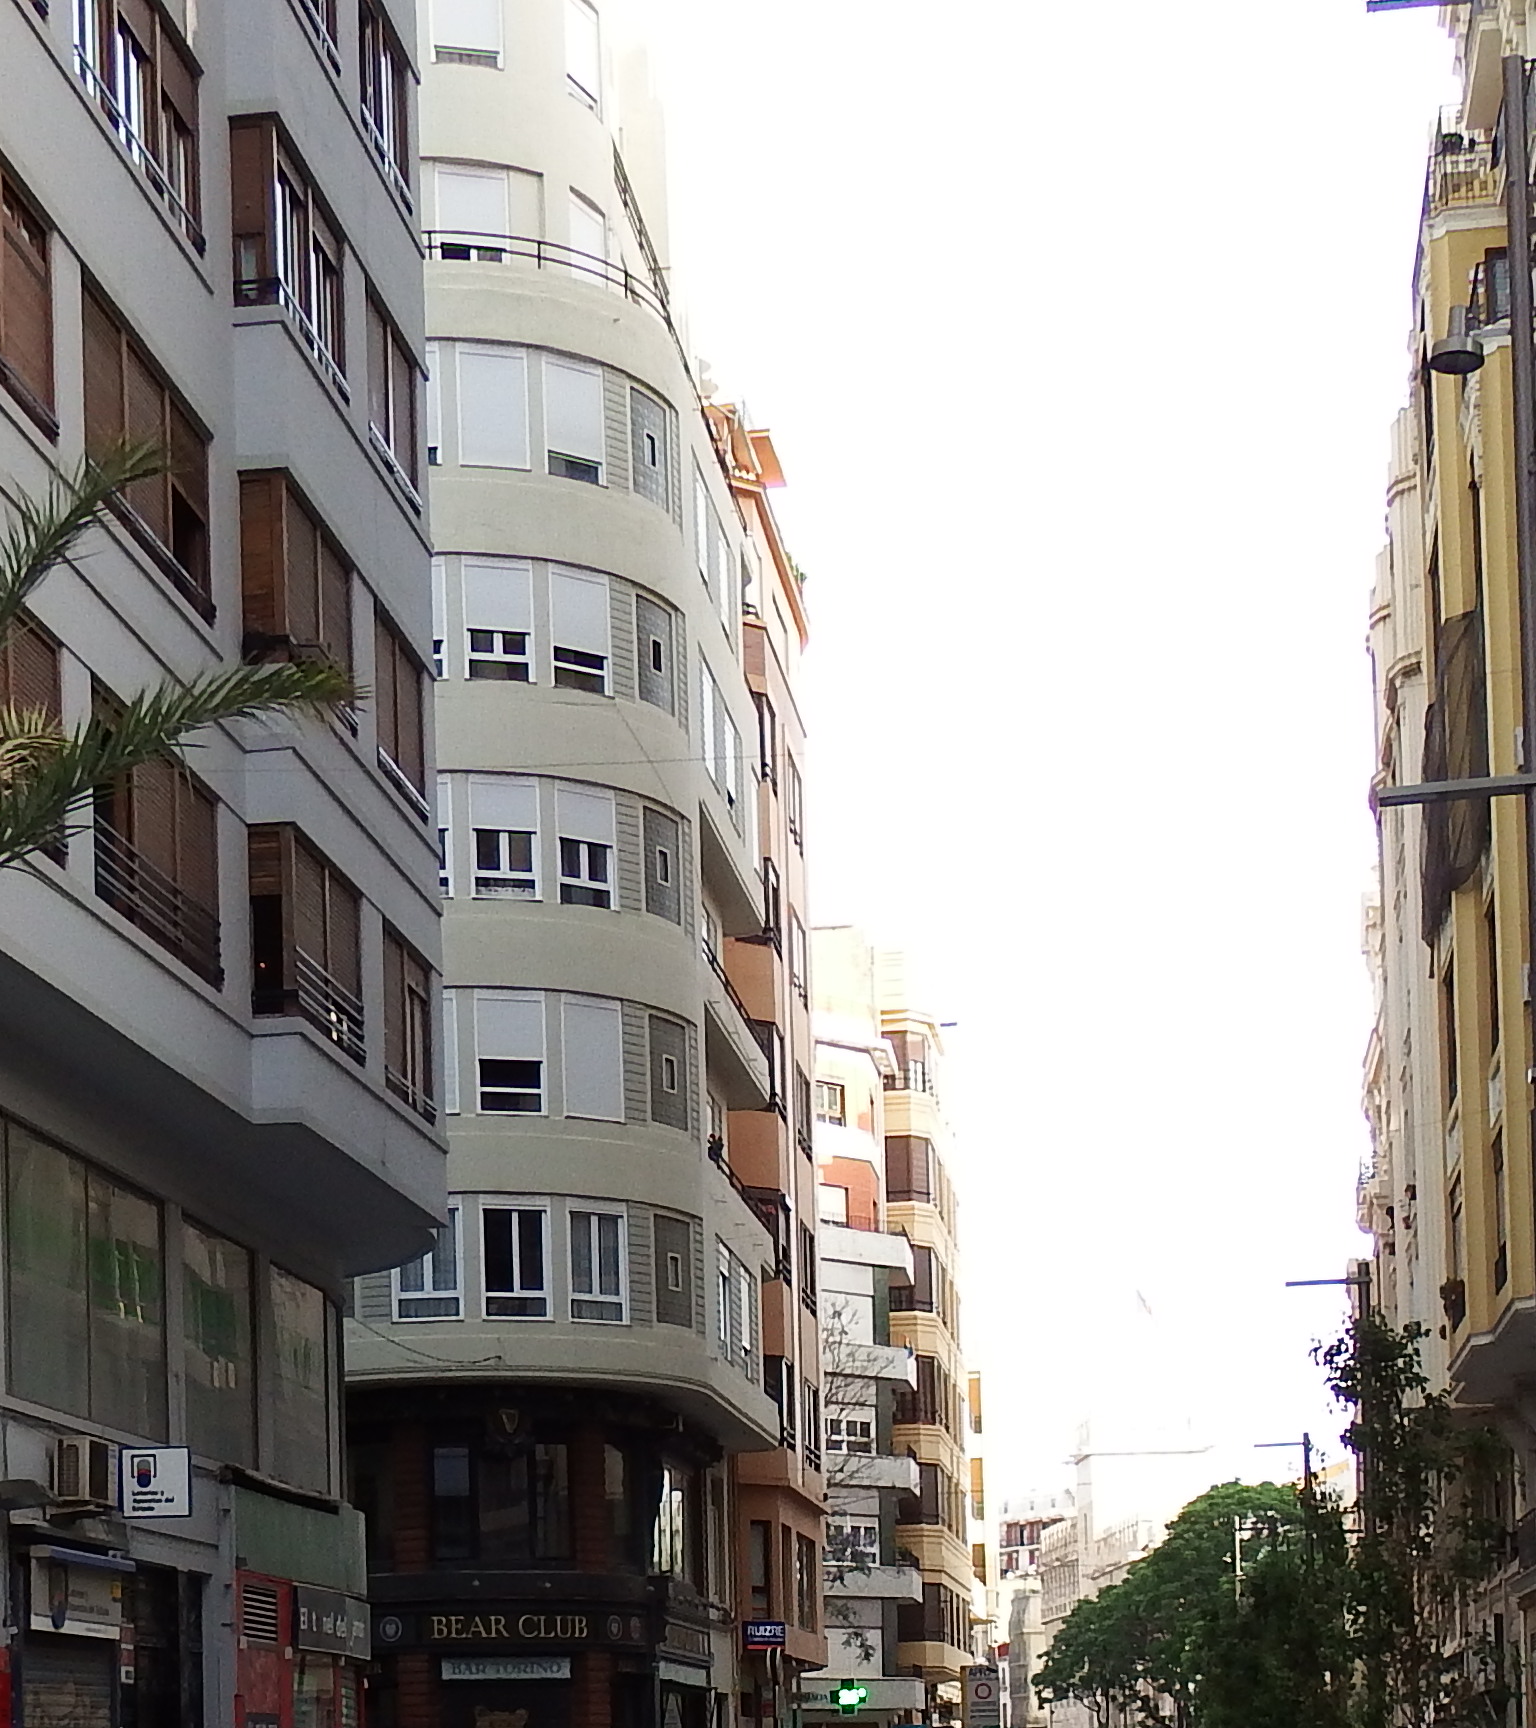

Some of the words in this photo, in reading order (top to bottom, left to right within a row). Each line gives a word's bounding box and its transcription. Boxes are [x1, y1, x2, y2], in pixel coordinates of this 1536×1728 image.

[430, 1615, 511, 1640] BEAR
[517, 1614, 589, 1639] CLUB
[451, 1662, 488, 1676] BAR
[494, 1661, 563, 1675] TORINO
